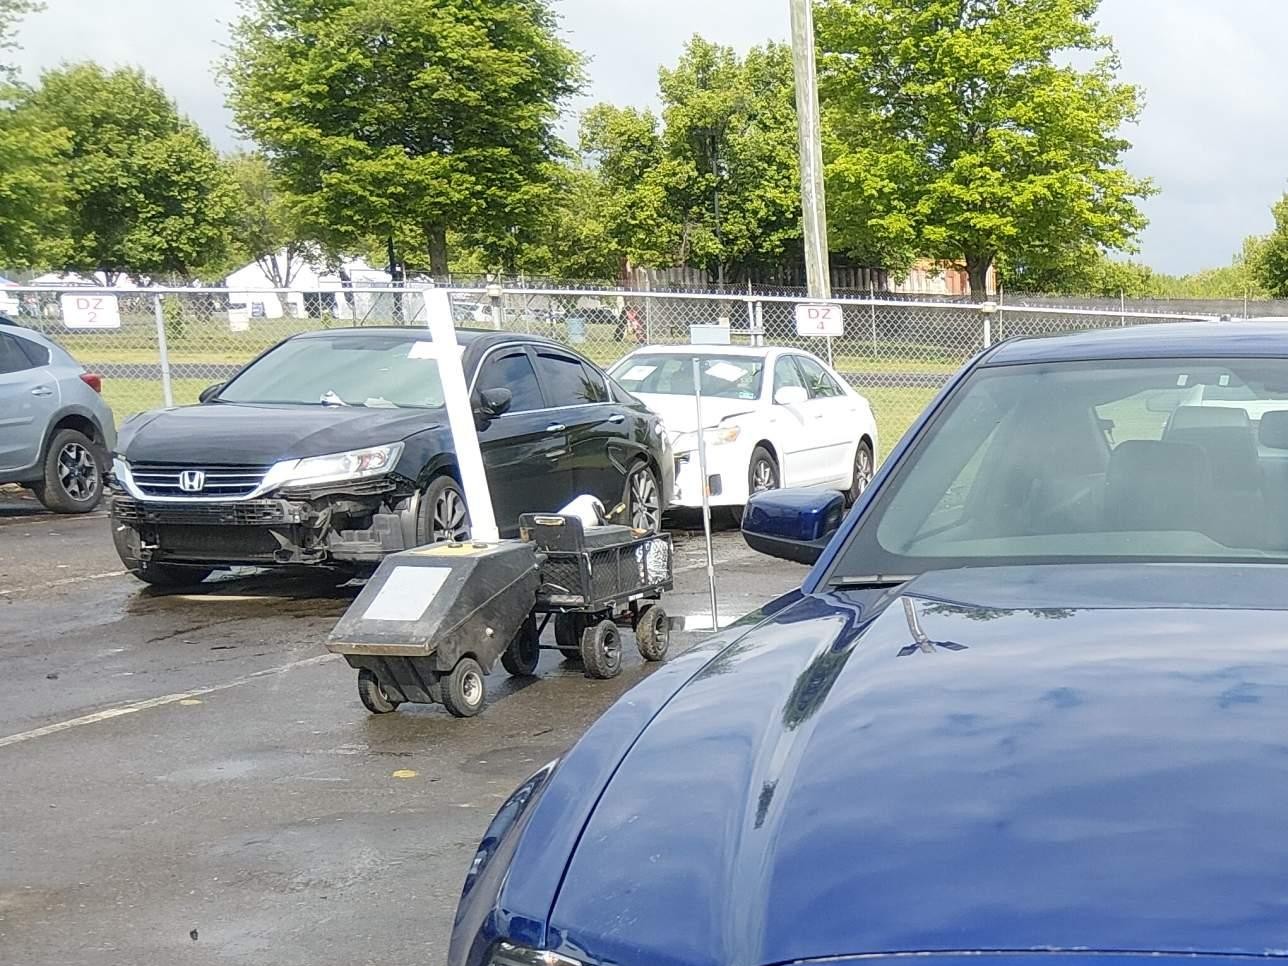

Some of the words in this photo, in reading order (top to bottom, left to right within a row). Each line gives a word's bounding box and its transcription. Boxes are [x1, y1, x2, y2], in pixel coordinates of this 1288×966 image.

[76, 298, 104, 310] DZ
[87, 311, 98, 323] 2
[807, 308, 832, 320] DZ
[816, 321, 825, 330] 4
